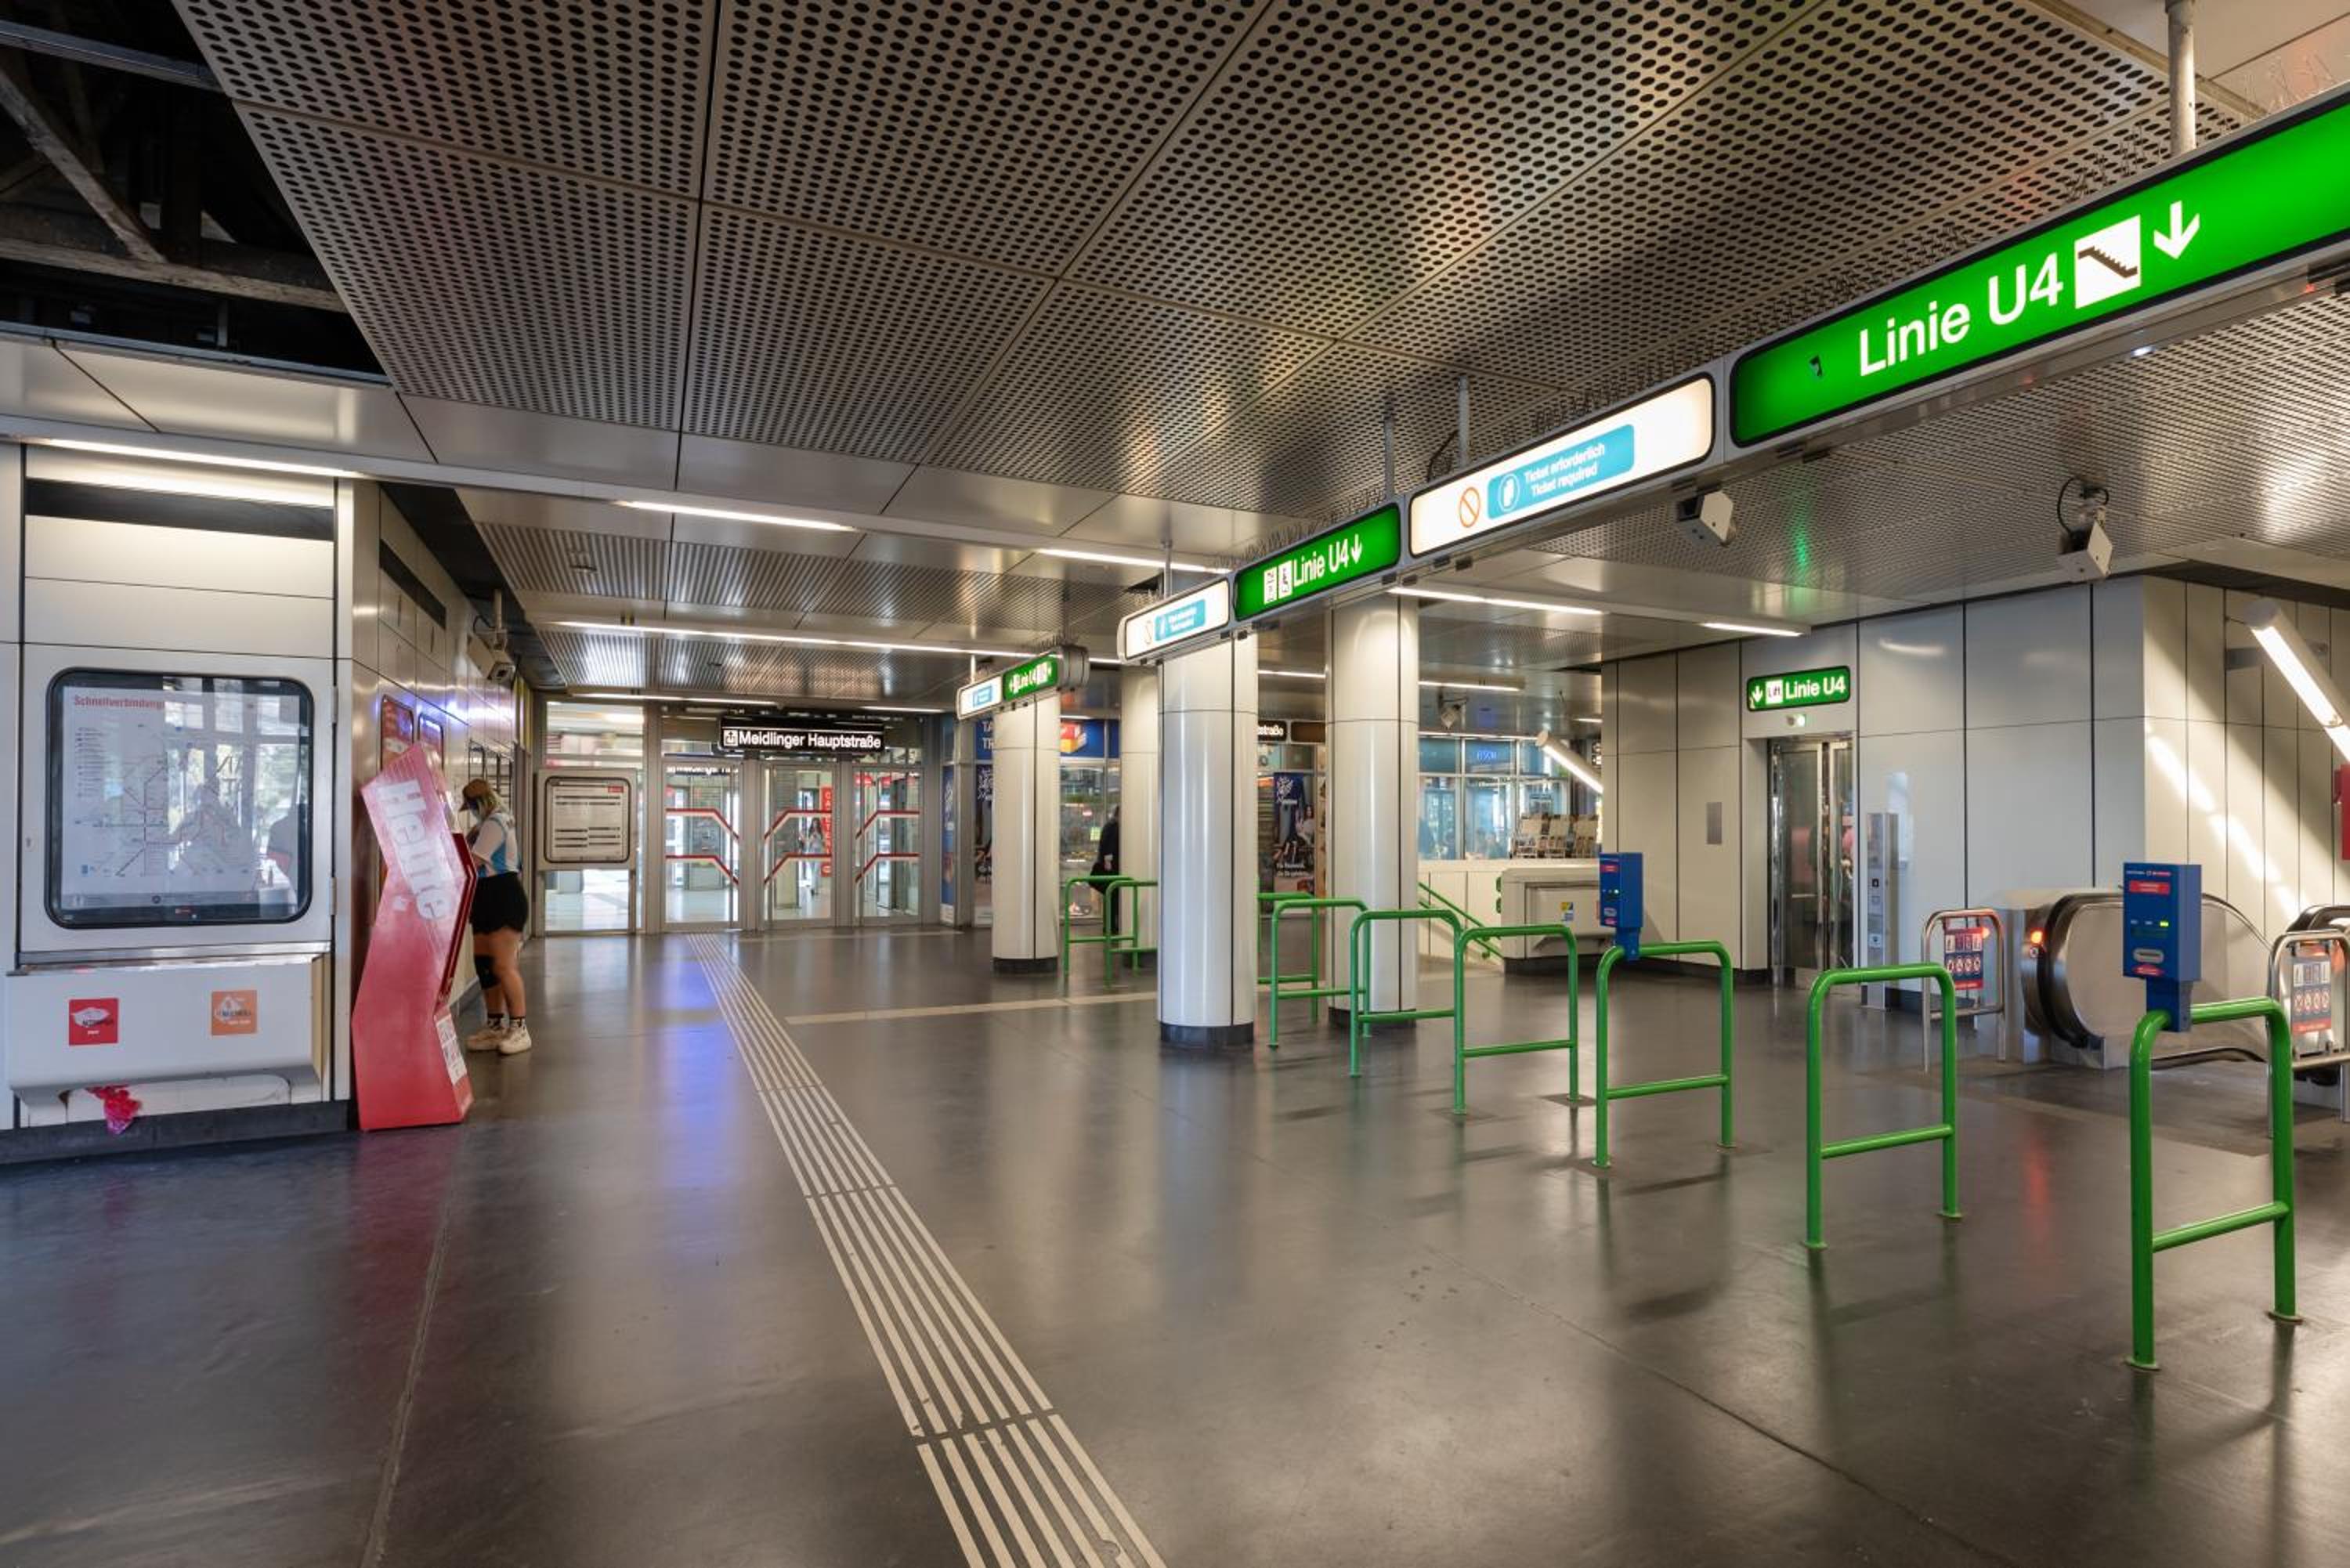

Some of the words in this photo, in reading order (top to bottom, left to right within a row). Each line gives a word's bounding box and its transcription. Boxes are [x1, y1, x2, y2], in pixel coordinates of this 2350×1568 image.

[1859, 301, 1971, 377] Linie
[1988, 252, 2064, 346] U4
[1524, 465, 1549, 484] Ticket
[1550, 443, 1605, 474] erforderlich
[1531, 479, 1556, 497] Ticket
[1557, 461, 1597, 489] required
[1293, 551, 1325, 587] Linie
[1329, 538, 1349, 573] U4
[75, 695, 165, 710] Schnellverbindung
[1785, 679, 1820, 699] Linie
[1823, 674, 1846, 695] U4
[739, 731, 805, 749] Meidlinger
[808, 734, 881, 750] Hauptstraße
